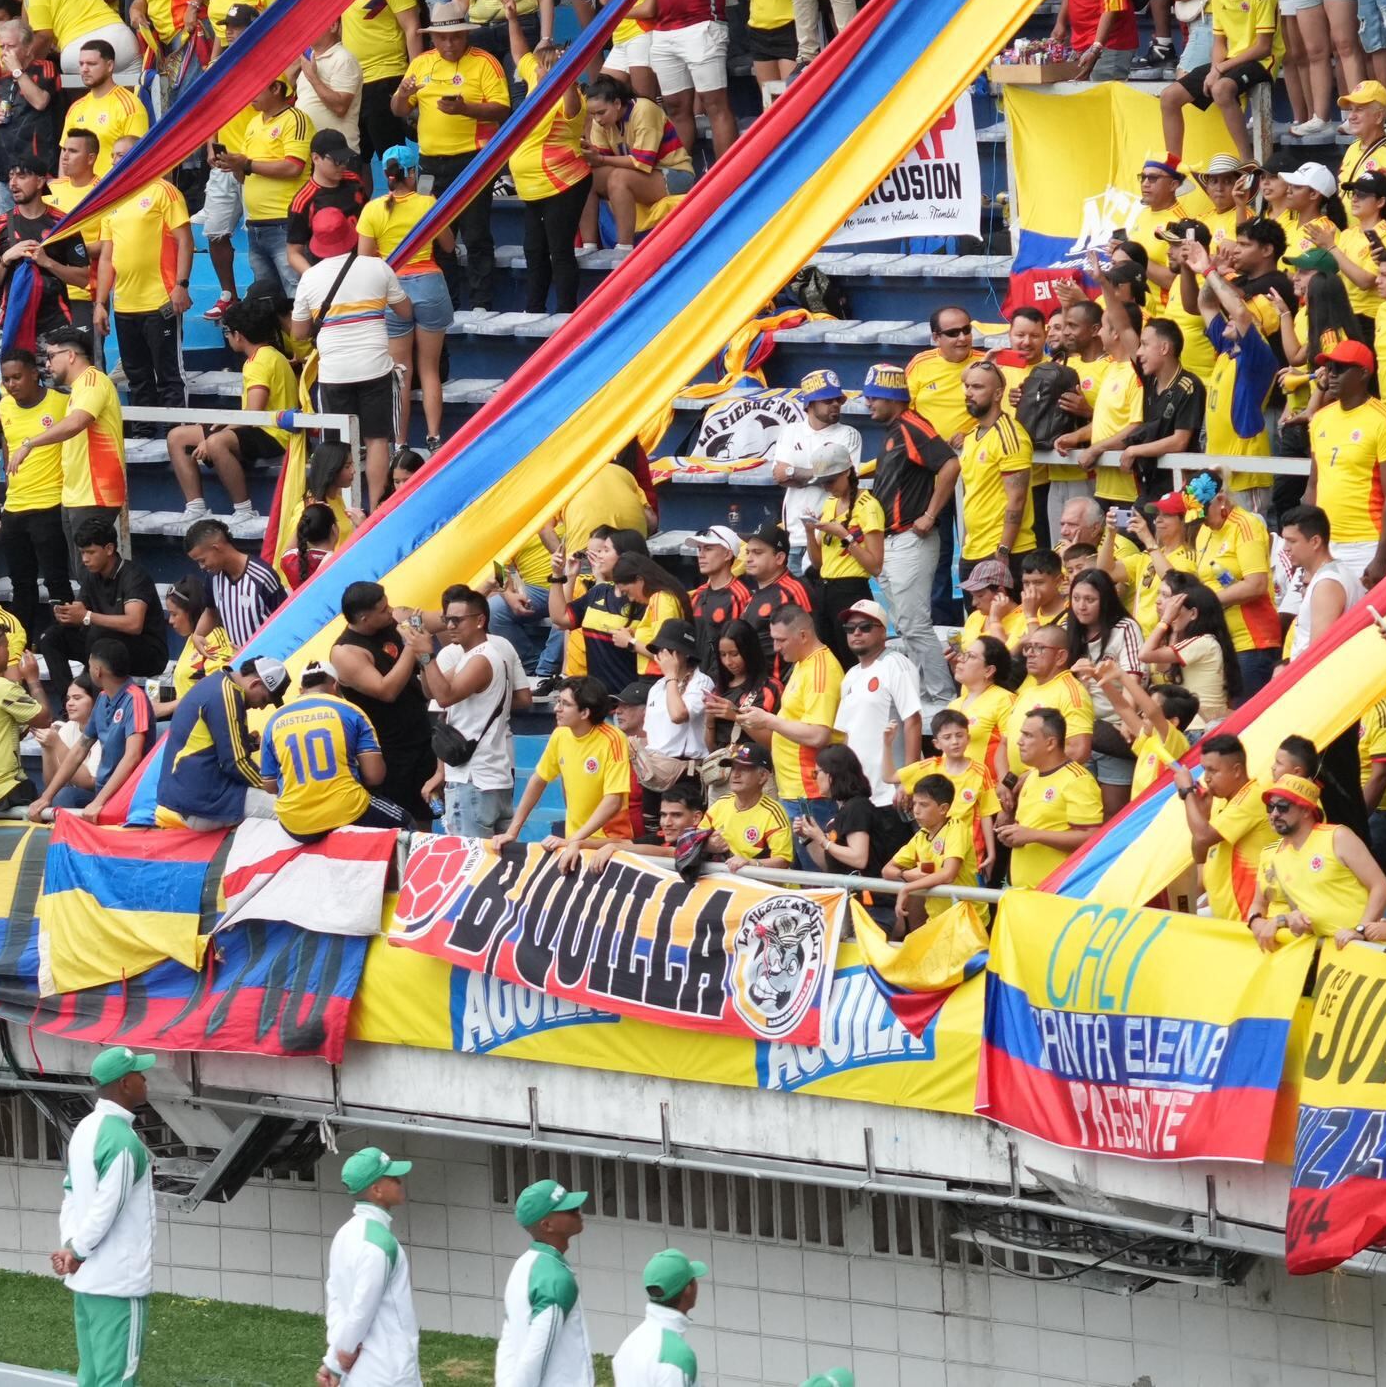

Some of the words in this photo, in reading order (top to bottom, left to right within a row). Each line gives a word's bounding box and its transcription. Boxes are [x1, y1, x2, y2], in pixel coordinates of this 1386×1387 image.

[1329, 447, 1339, 468] 7
[275, 712, 337, 731] ARISTIZABAL
[284, 728, 338, 786] 10
[1046, 903, 1169, 1011] CALI
[1123, 1016, 1230, 1085] ELENA
[1070, 1079, 1194, 1155] PRESENTE
